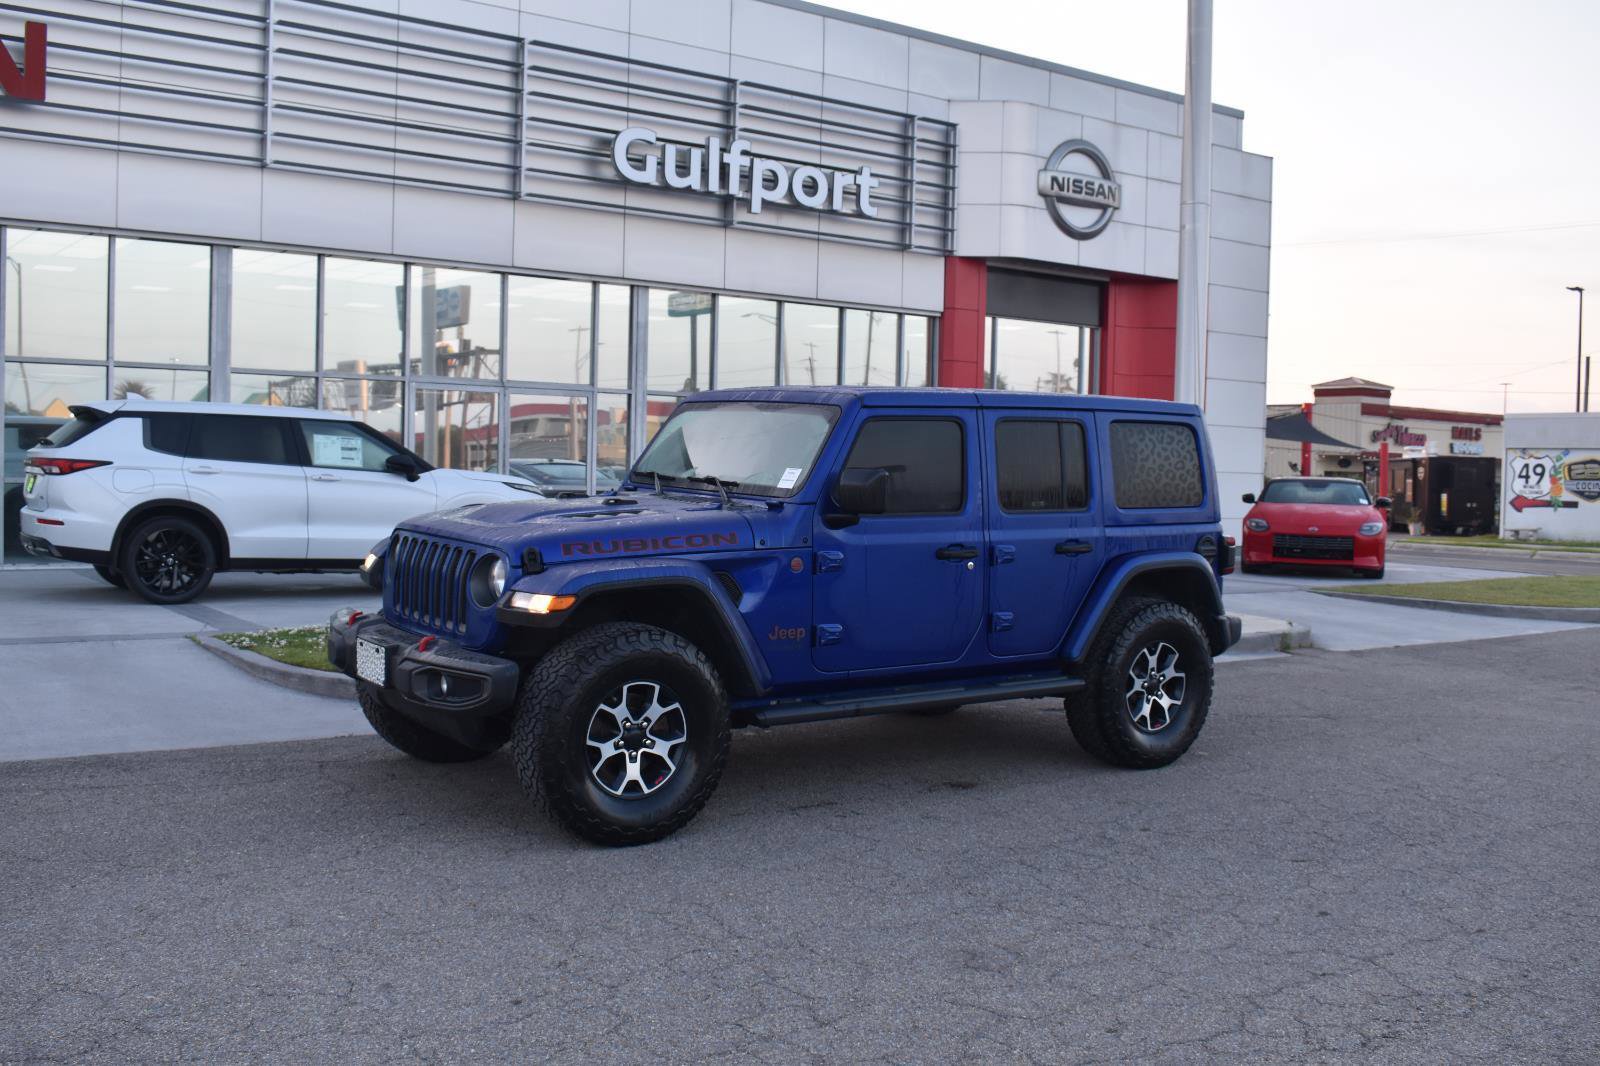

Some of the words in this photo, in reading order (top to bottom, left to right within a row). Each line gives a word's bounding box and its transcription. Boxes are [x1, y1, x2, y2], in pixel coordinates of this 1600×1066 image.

[611, 127, 880, 217] Gulfport
[1050, 175, 1117, 203] NISSAN
[1518, 463, 1546, 486] 49
[561, 532, 738, 556] RUBICON
[768, 624, 806, 641] Jeep
